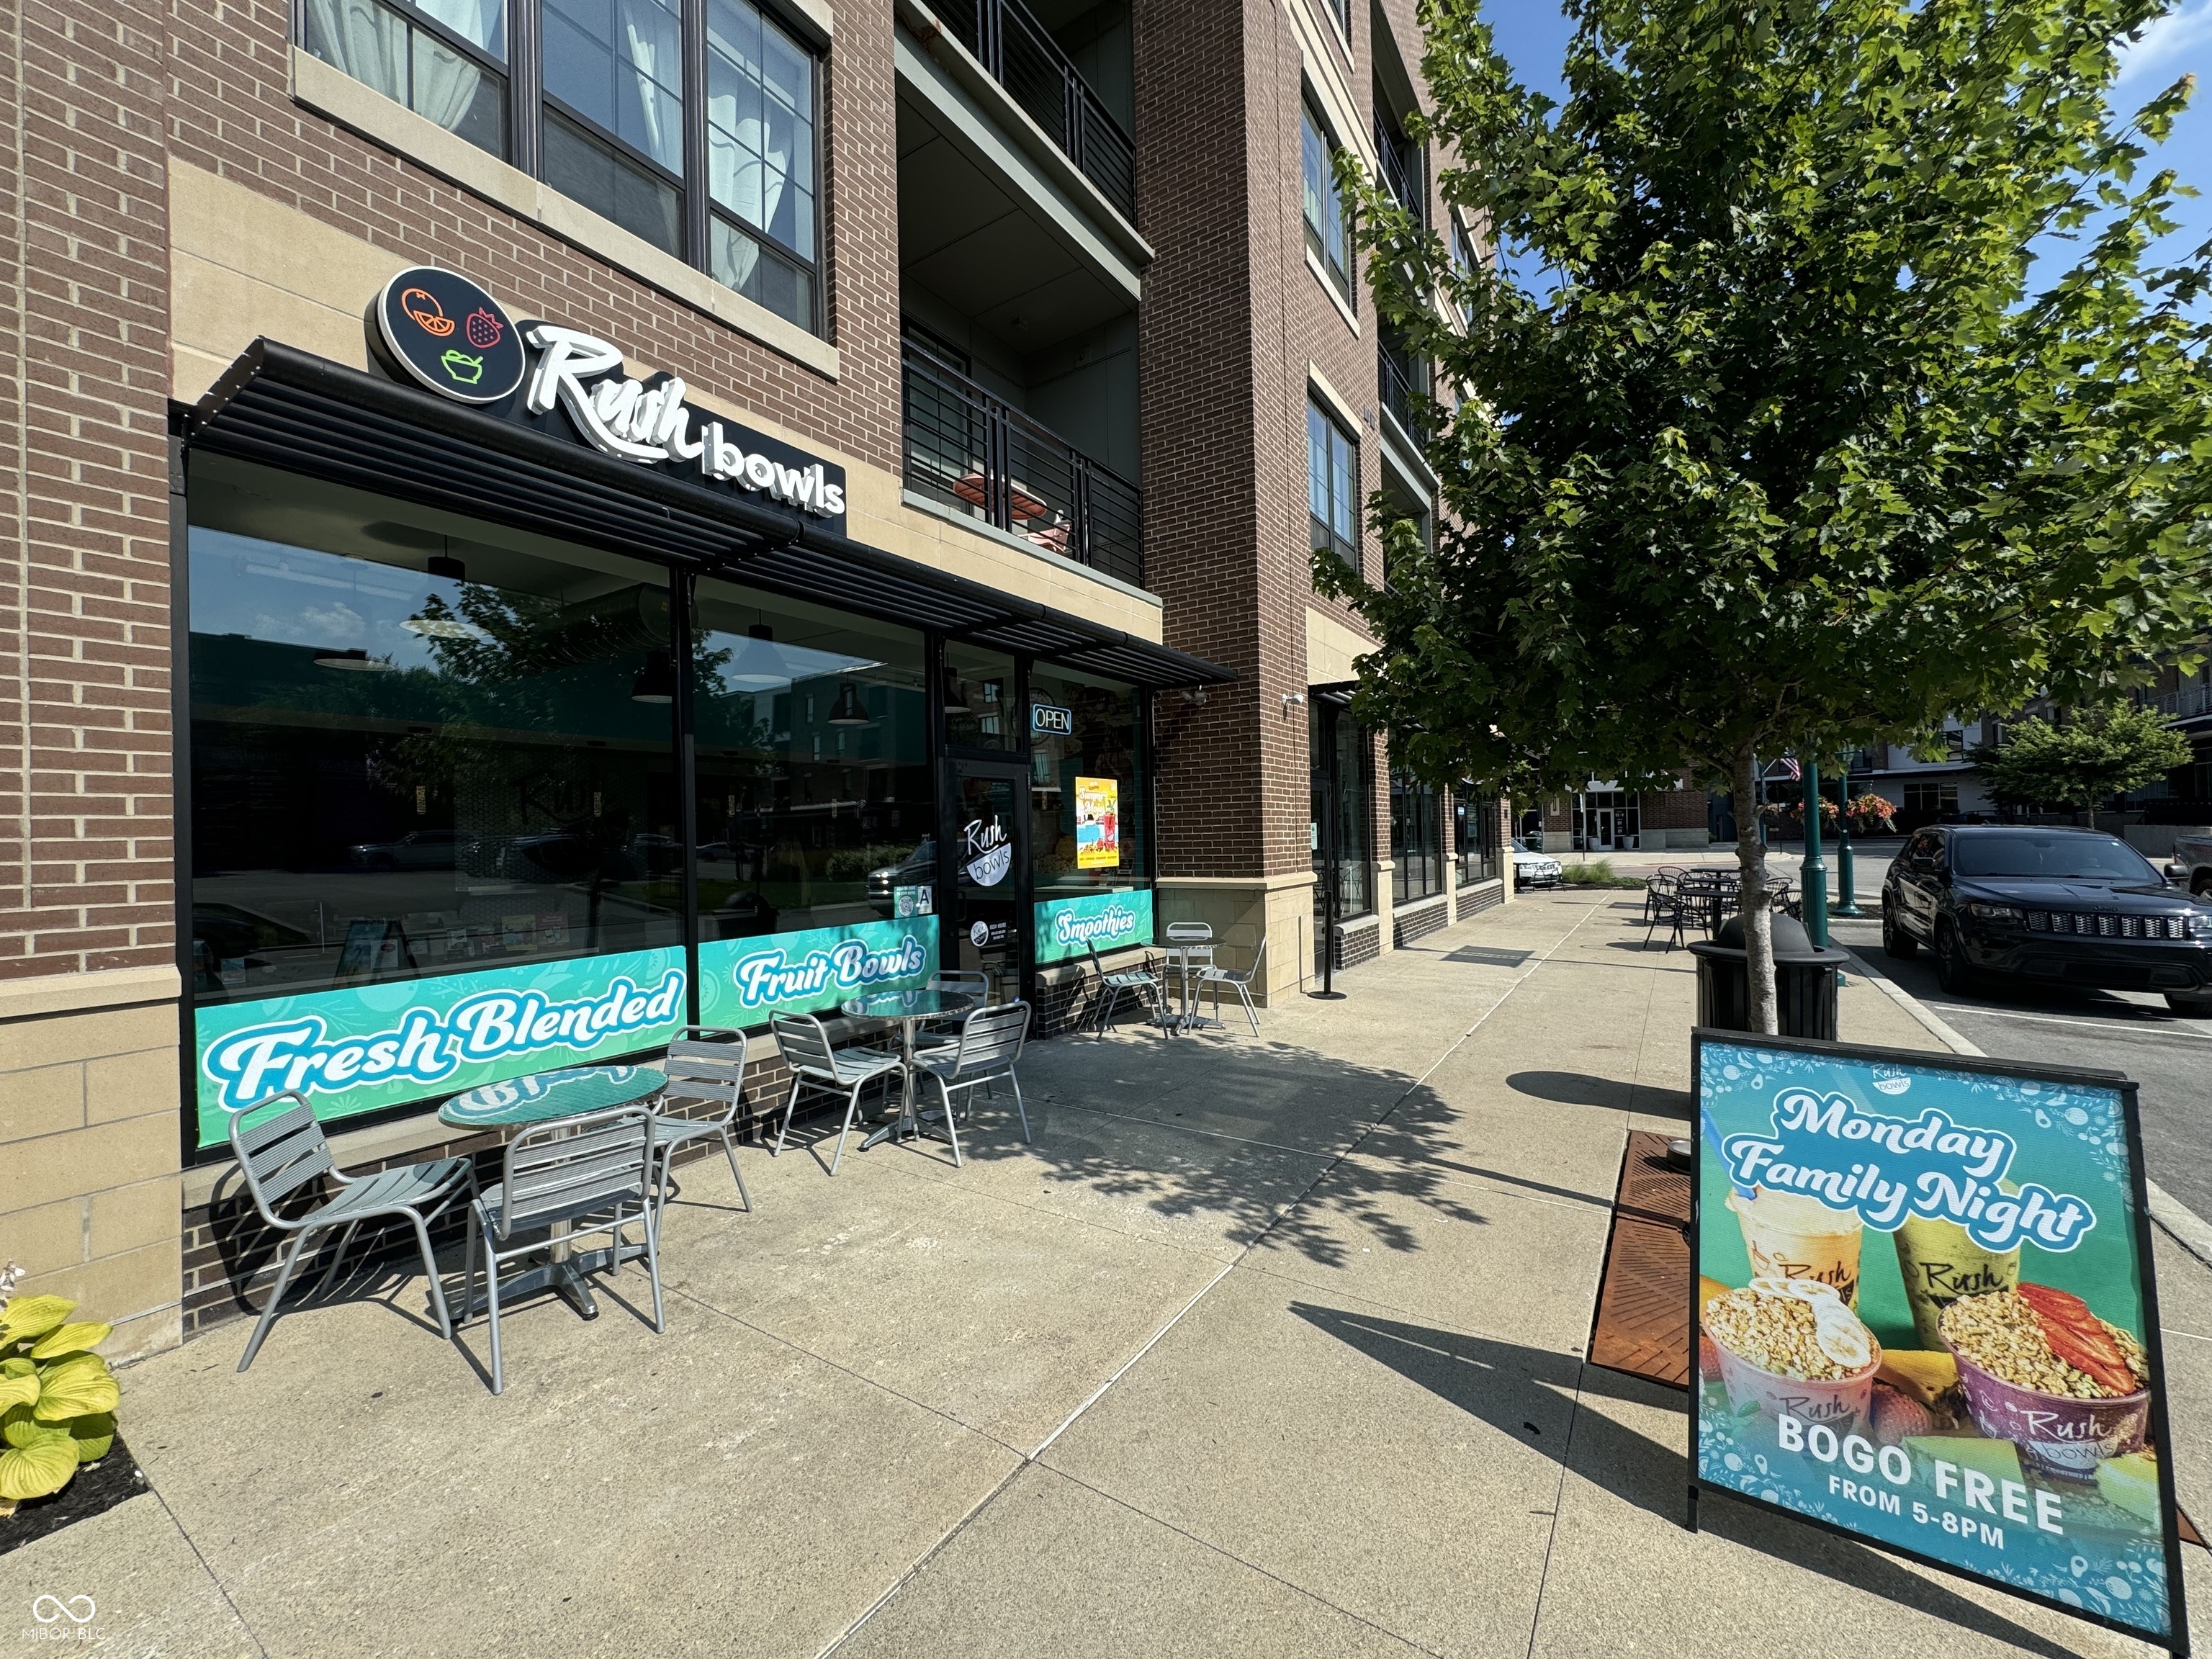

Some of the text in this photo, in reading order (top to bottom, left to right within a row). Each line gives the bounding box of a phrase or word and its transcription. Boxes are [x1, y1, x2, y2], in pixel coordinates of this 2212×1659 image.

[526, 324, 846, 518] Rush bowls
[1035, 708, 1070, 731] OPEN
[963, 814, 1007, 855] Rush
[974, 849, 1010, 880] bowls
[920, 889, 930, 904] A
[1057, 909, 1134, 942] Smoothies
[740, 940, 922, 1001] Fruit Bowls
[220, 1013, 449, 1101] Fresh
[456, 975, 678, 1053] Blended
[1870, 1064, 1907, 1080] Rush
[1877, 1079, 1910, 1091] bowls
[1781, 1093, 2005, 1179] Monday
[1731, 1140, 2085, 1244] Family Night
[1918, 1262, 2004, 1295] Rush
[1779, 1394, 1851, 1423] Rush
[2020, 1409, 2113, 1444] Rush
[2041, 1441, 2115, 1460] bowls
[1778, 1413, 2064, 1536] BOGO FREE
[1828, 1475, 2005, 1550] FROM 5-8PM
